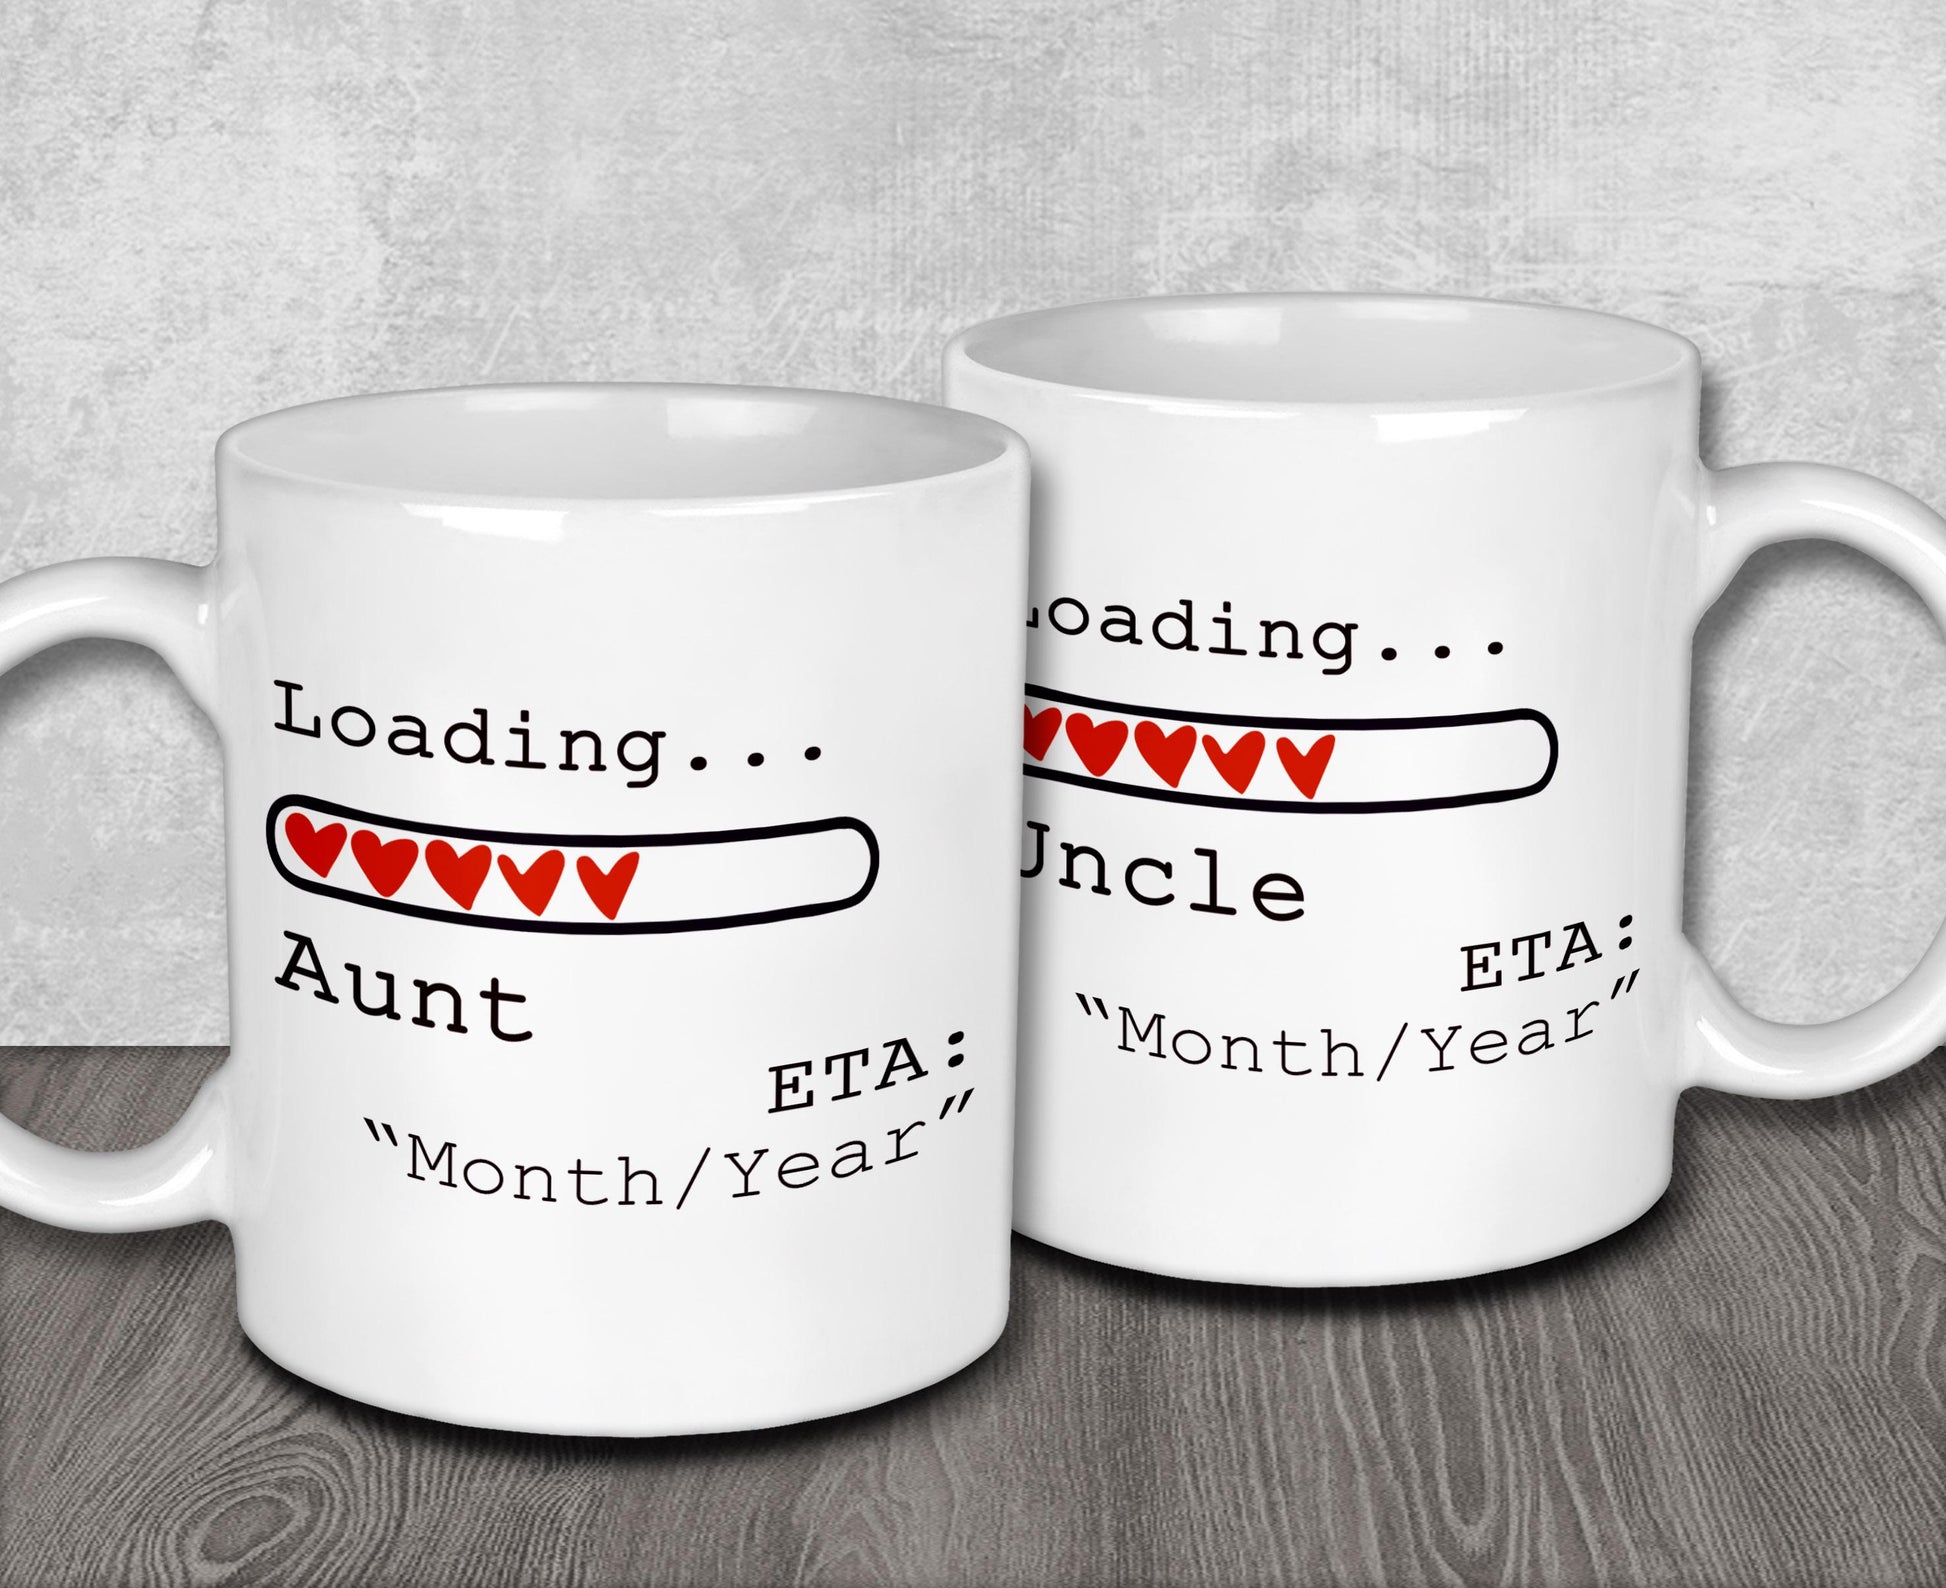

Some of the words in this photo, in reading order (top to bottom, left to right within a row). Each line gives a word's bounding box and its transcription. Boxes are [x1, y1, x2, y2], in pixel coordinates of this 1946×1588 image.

[1026, 597, 1504, 676] oading...
[273, 679, 825, 789] Loading...
[274, 931, 534, 1043] Aunt
[1460, 914, 1641, 993] ETA:
[767, 1030, 966, 1114] ETA:
